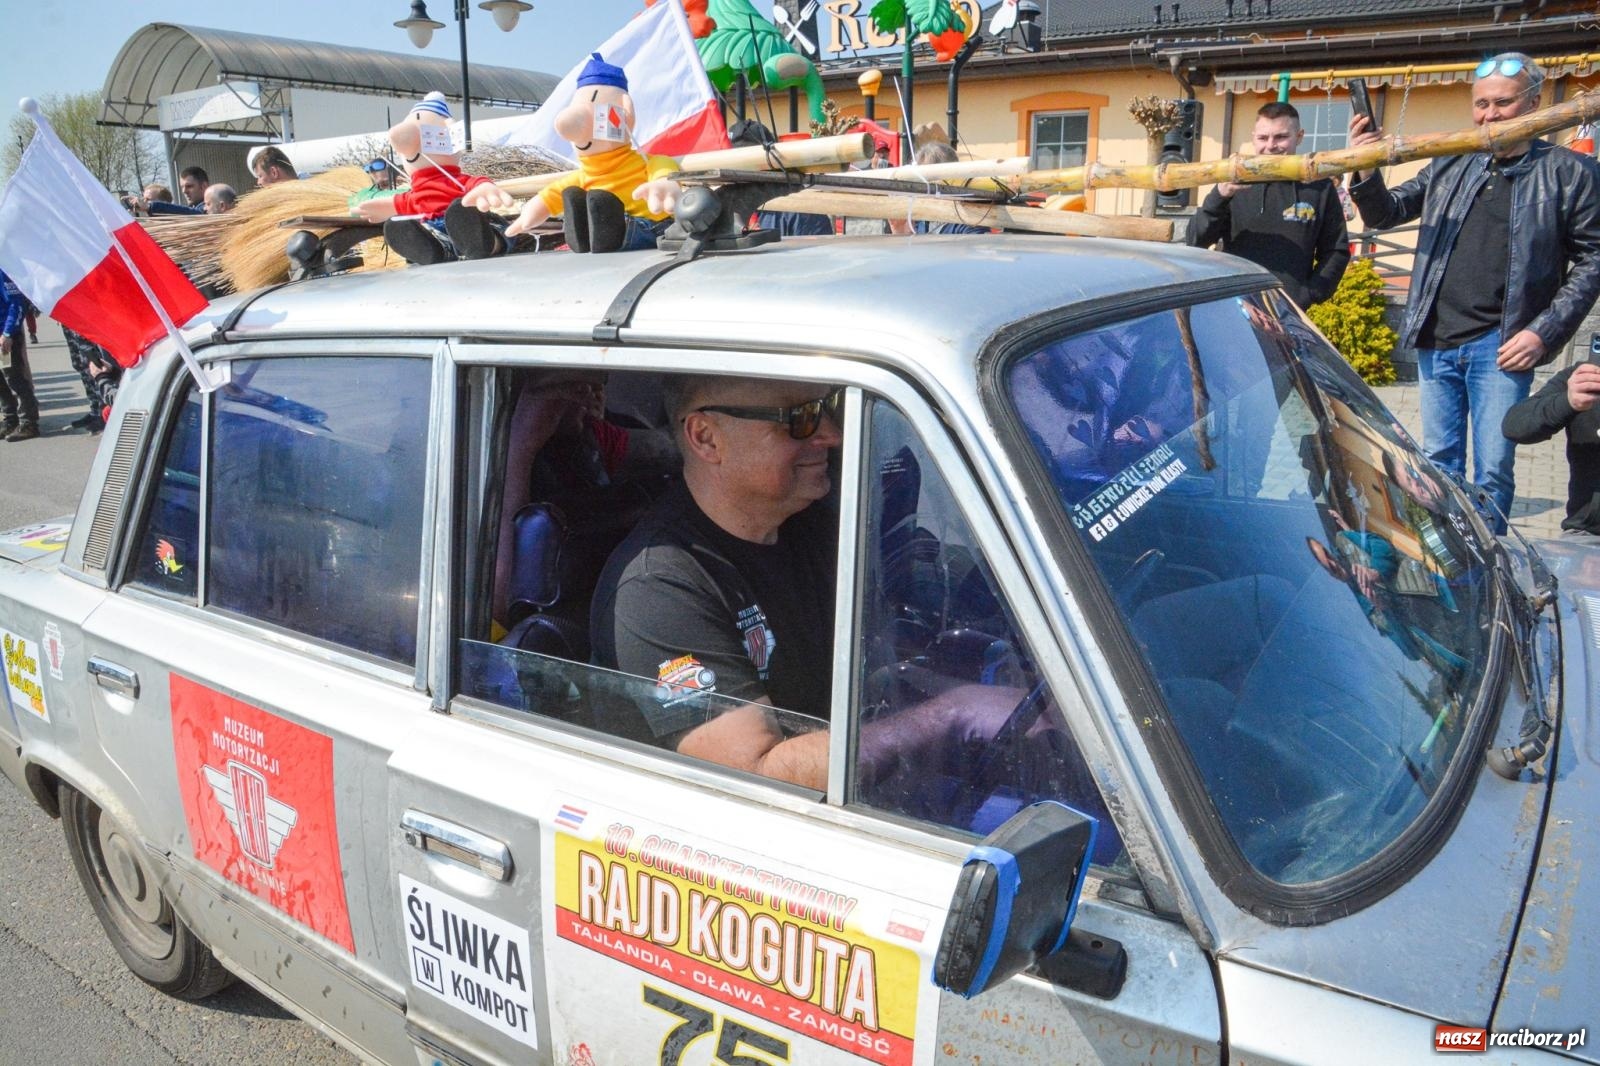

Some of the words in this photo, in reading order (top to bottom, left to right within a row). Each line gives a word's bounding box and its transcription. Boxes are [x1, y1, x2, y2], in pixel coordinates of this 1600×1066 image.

[1113, 485, 1154, 522] ŁOWICKIE
[212, 731, 280, 776] MOTORYZACJI
[224, 716, 264, 748] MUZEUM
[603, 822, 638, 862] 10.
[638, 834, 858, 932] CHARYTATYWNY
[407, 887, 527, 992] ŚLIWKA
[578, 850, 681, 947] RAJD
[688, 889, 880, 1032] KOGUTA
[421, 957, 435, 983] W
[451, 970, 528, 1033] KOMPOT
[572, 921, 673, 972] TAJLANDIA
[693, 970, 766, 1009] OŁAWA
[788, 1006, 891, 1055] ZAMOŚĆ
